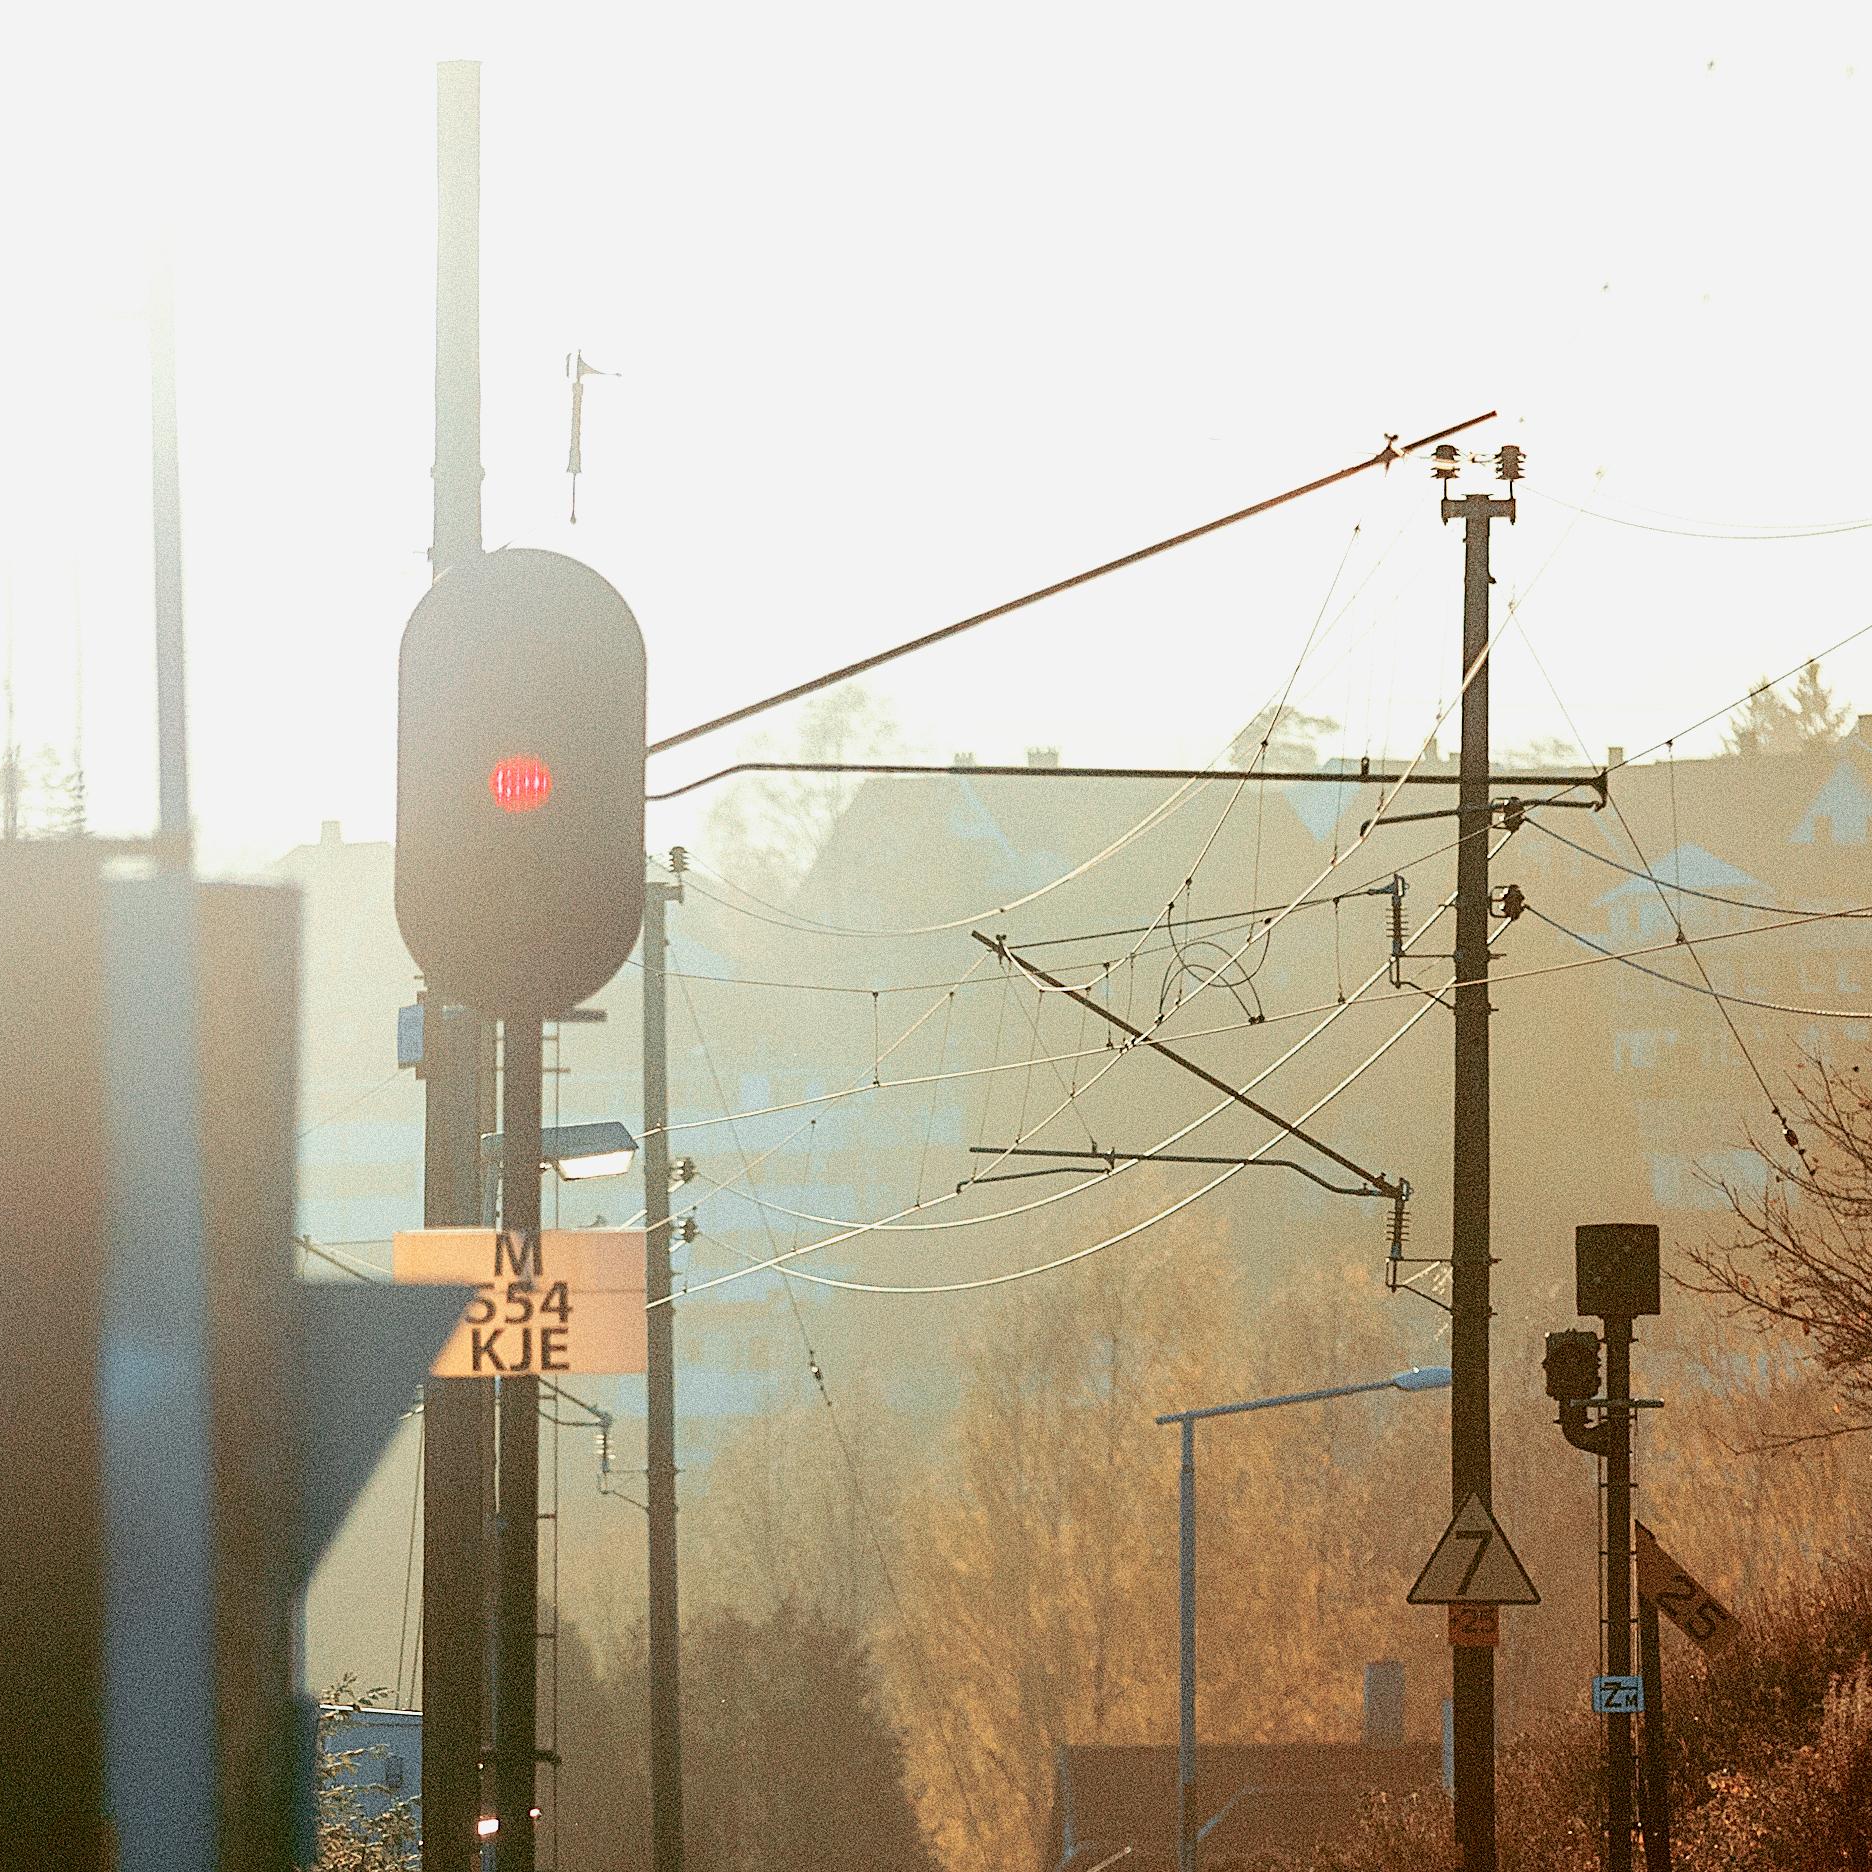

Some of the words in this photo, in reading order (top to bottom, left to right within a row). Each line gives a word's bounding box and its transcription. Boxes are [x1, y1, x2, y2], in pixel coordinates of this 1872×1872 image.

[494, 1233, 543, 1276] M
[465, 1281, 573, 1324] 554
[472, 1327, 570, 1372] KJE
[1455, 1530, 1493, 1596] 7
[1656, 1573, 1728, 1642] 25
